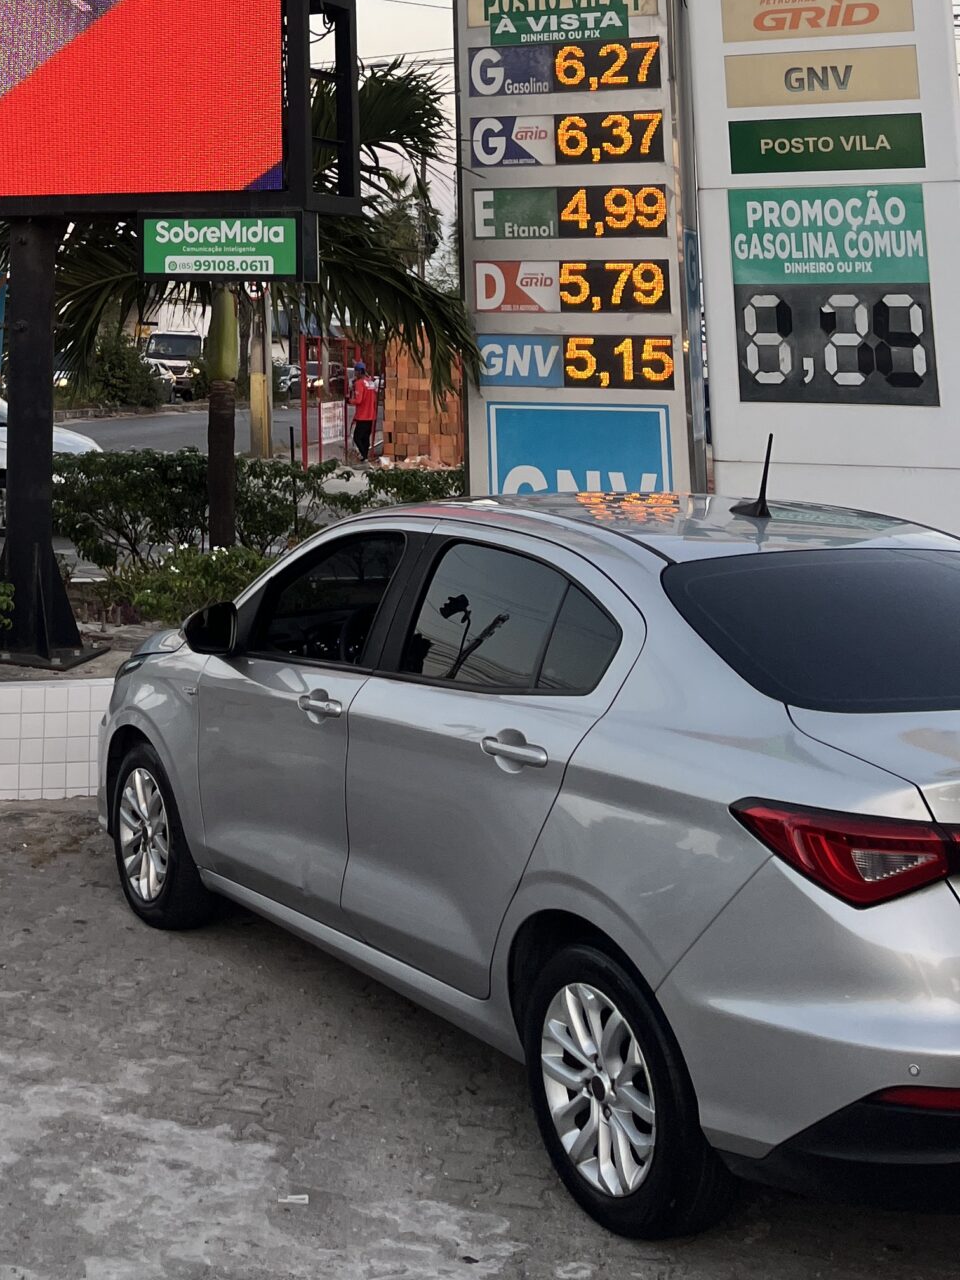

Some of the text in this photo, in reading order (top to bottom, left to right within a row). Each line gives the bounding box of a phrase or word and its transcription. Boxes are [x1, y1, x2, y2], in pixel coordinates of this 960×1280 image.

[495, 11, 623, 34] À VISTA
[520, 29, 600, 42] DINHEIRO OU PIX
[471, 41, 660, 95] G Gasolina 6,27
[784, 65, 853, 92] GNV
[473, 118, 506, 165] G
[557, 112, 662, 162] 6,37
[760, 134, 891, 154] POSTO VILA
[474, 187, 666, 237] E Etanol 4,99
[746, 190, 906, 231] PROMOÇÃO
[224, 245, 256, 254] Inteligente
[734, 230, 924, 259] GASOLINA COMUM
[194, 260, 269, 272] 99108.0611
[784, 261, 873, 273] DINHEIRO OU PIX
[476, 263, 505, 309] D
[559, 263, 664, 311] 5,79
[481, 344, 560, 377] GNV
[566, 338, 673, 387] 5,15
